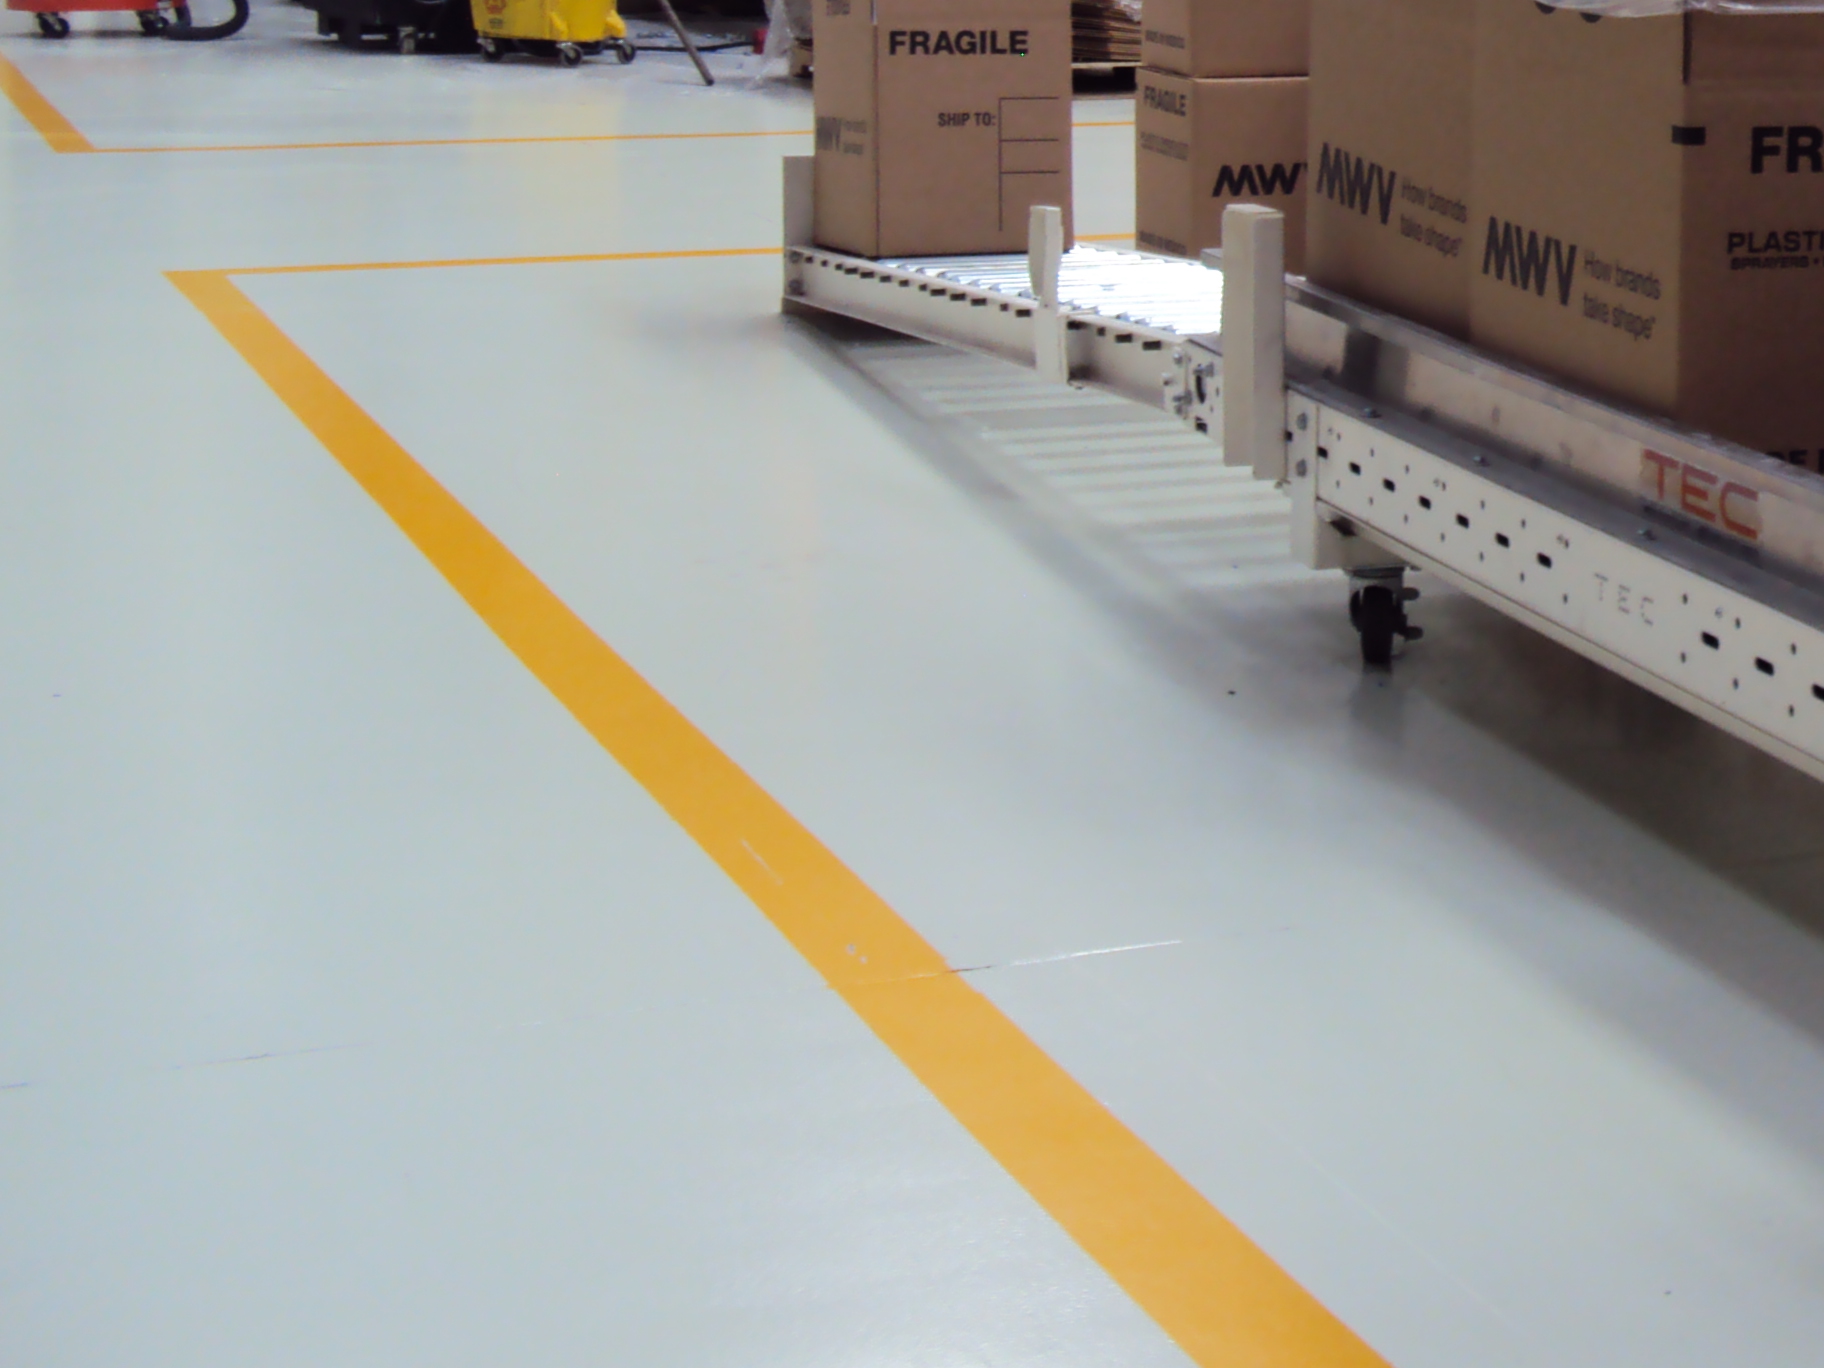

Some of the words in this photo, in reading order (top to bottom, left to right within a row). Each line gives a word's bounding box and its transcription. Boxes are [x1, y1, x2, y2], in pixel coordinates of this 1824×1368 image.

[889, 30, 1029, 55] FRAGILE
[938, 112, 970, 127] SHIP
[974, 112, 996, 127] TO:
[1212, 162, 1308, 197] MW
[1316, 142, 1397, 225] MWV
[1482, 216, 1578, 306] MWV
[1615, 260, 1662, 300] brands
[1643, 448, 1759, 541] TEC
[1594, 572, 1655, 627] TEC
